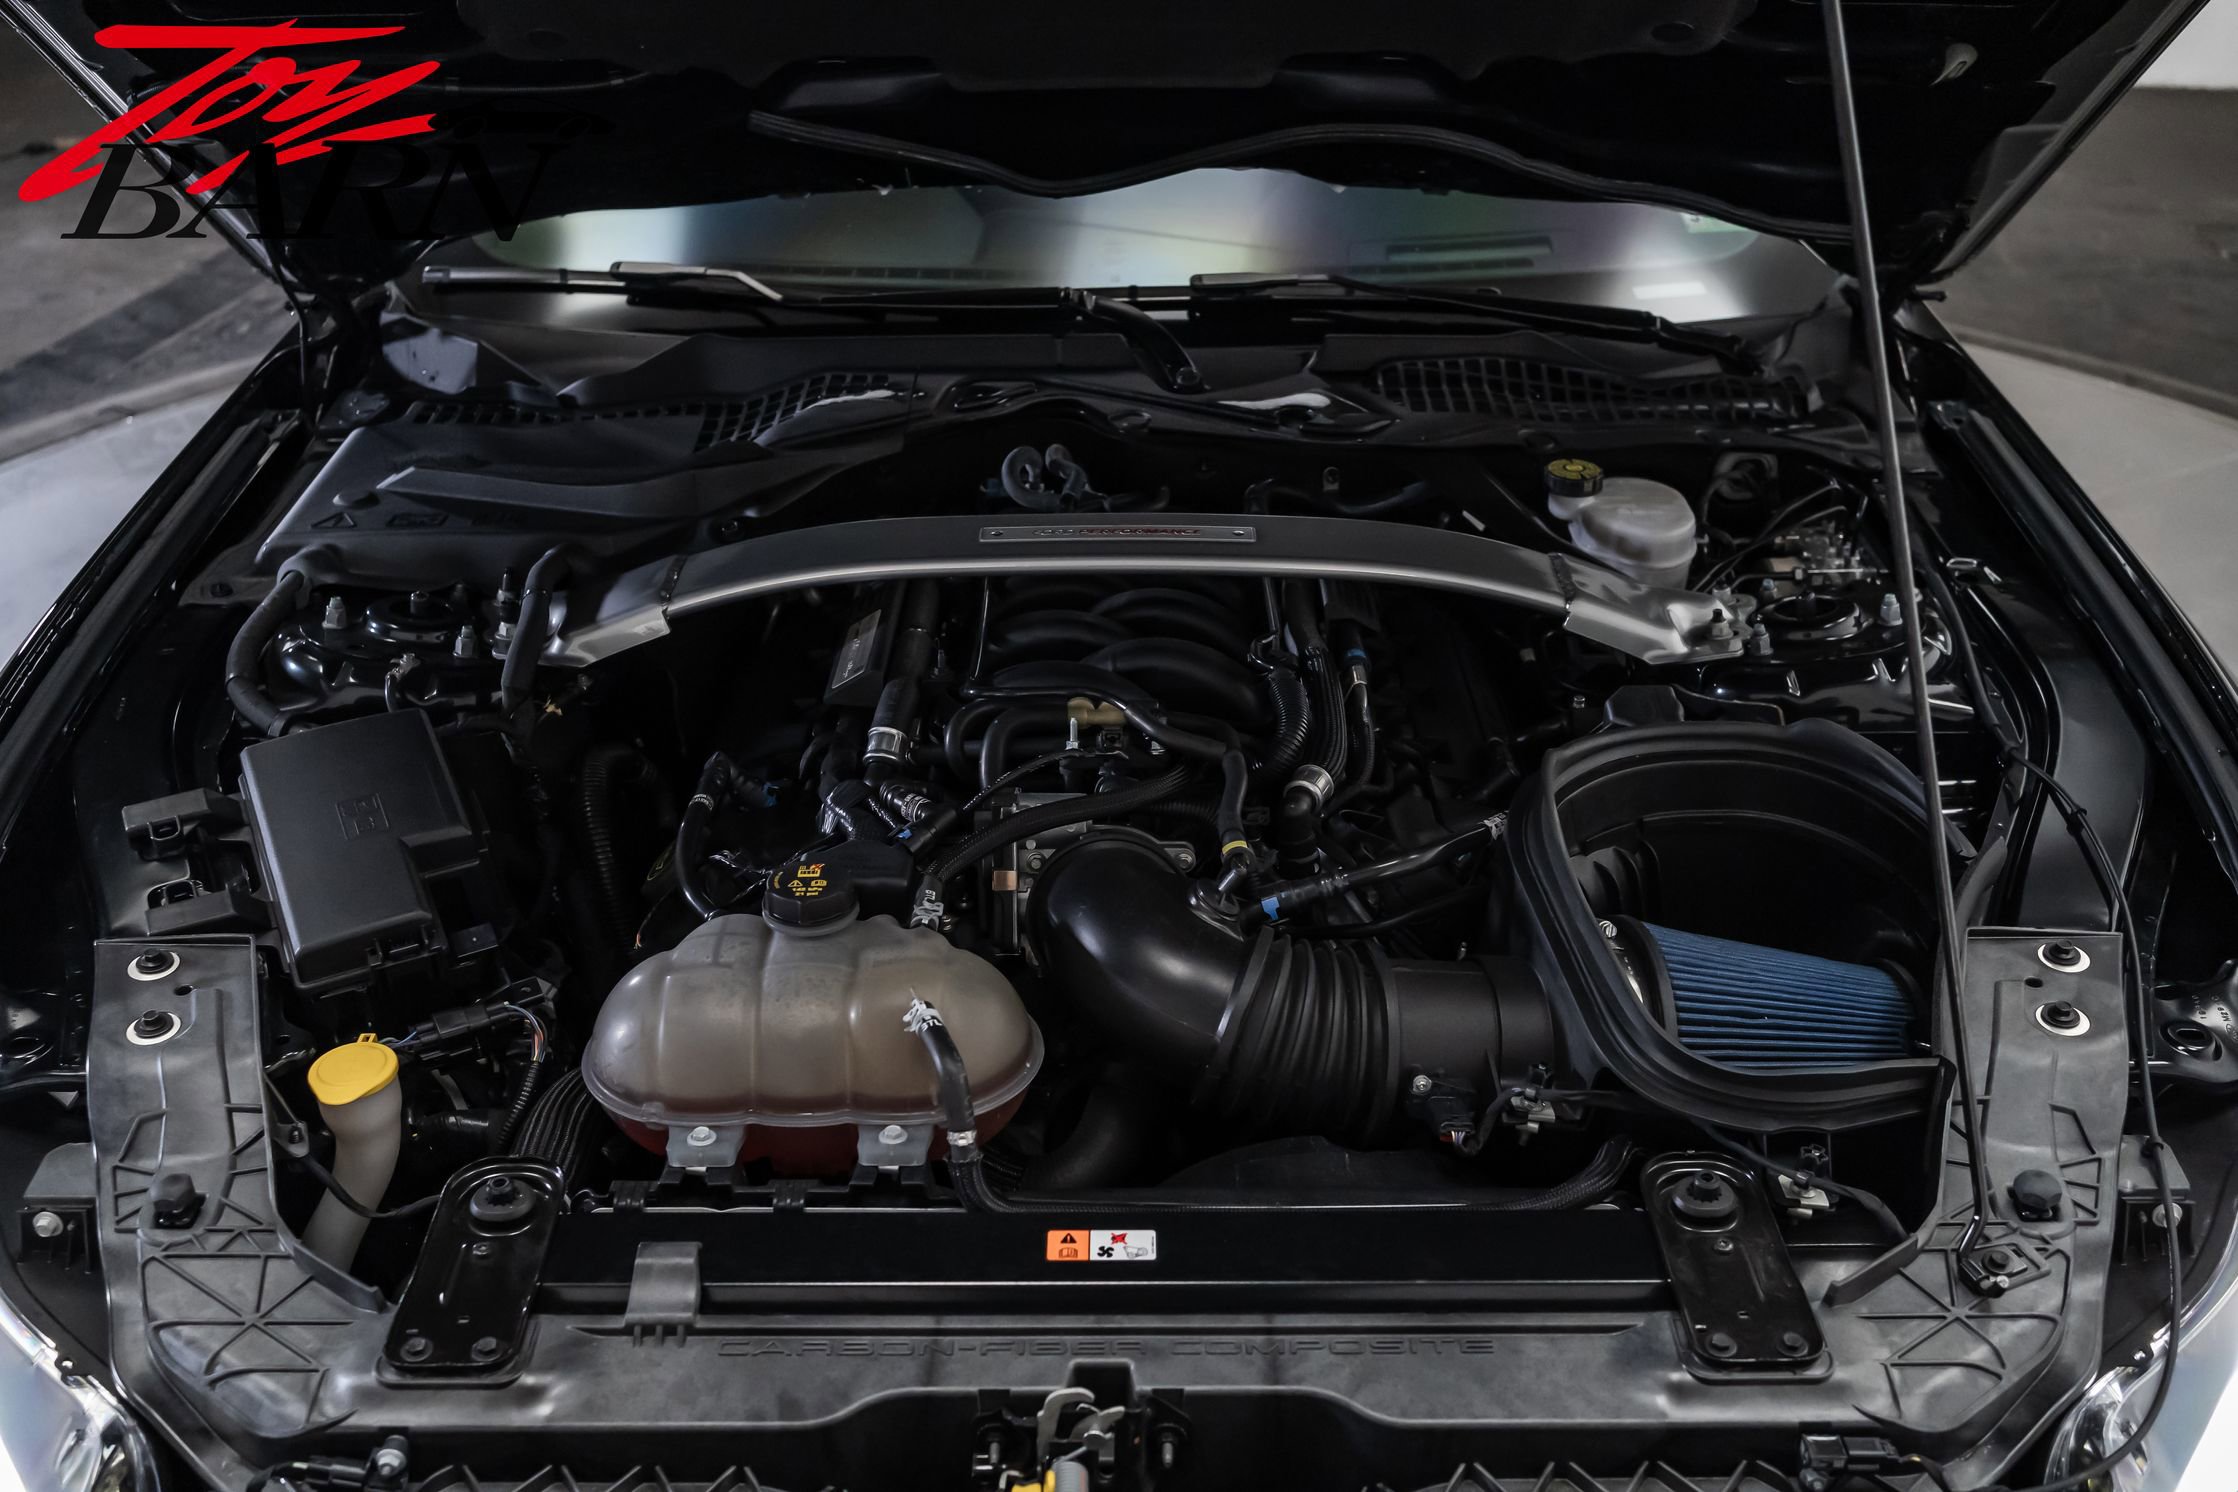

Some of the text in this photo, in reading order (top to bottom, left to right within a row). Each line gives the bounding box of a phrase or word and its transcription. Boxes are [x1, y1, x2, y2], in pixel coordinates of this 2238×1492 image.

[1079, 528, 1201, 536] PERFORMANCE
[718, 1340, 1496, 1357] CARBON-FIBER COMPOSITE
